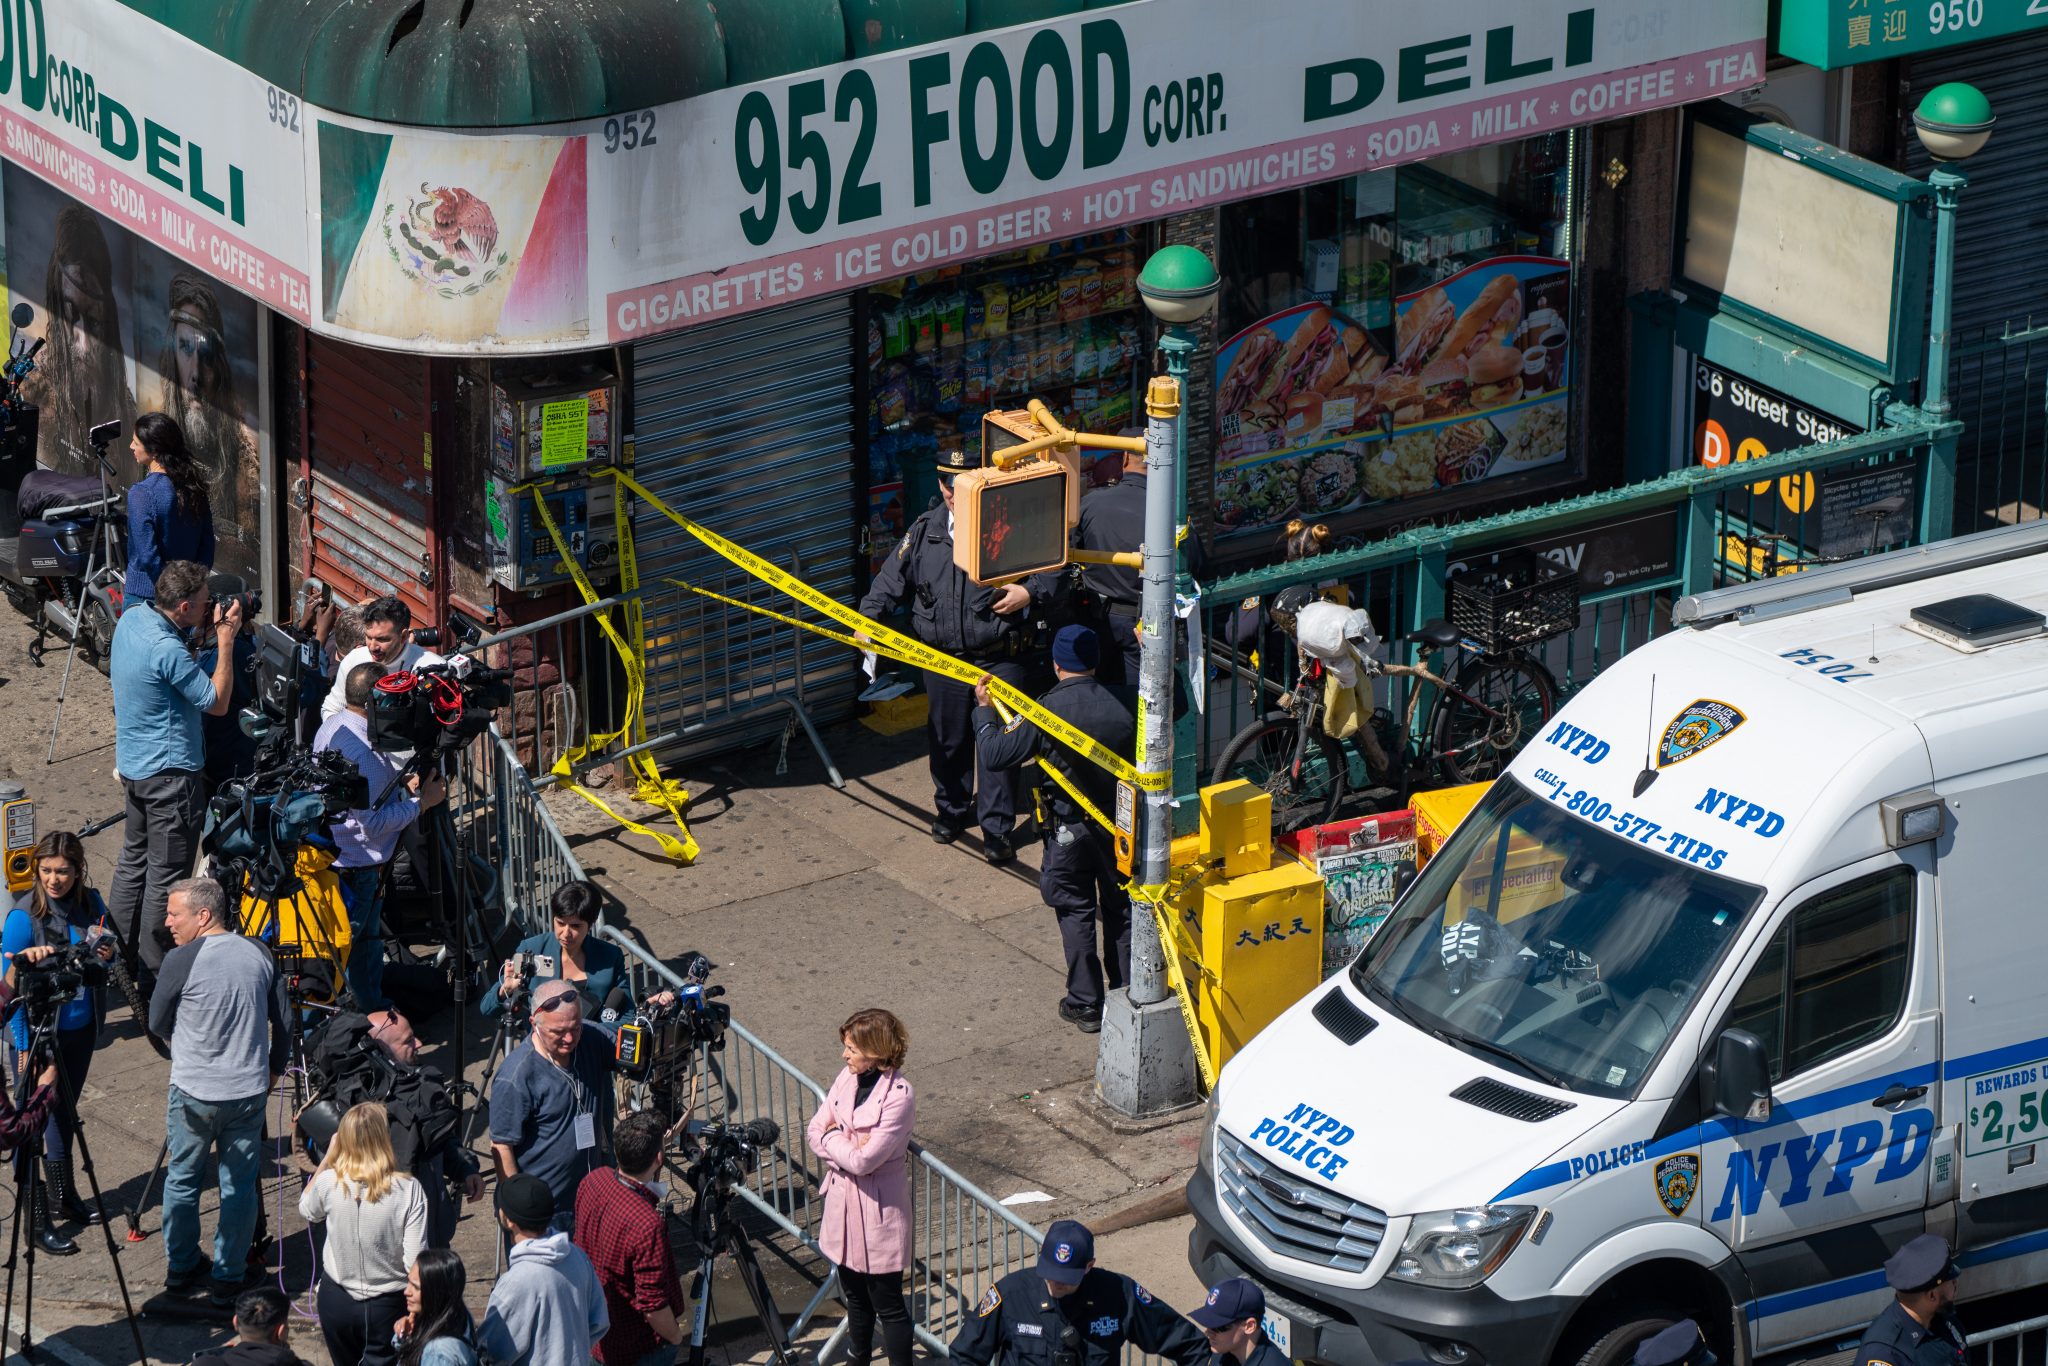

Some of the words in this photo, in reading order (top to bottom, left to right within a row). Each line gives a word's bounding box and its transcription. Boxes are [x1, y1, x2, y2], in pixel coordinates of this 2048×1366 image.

[1929, 0, 1983, 35] 950
[1302, 8, 1596, 124] DELI
[48, 53, 100, 138] CORP.
[267, 85, 299, 134] 952
[604, 109, 657, 154] 952
[735, 68, 882, 247] 952
[909, 18, 1131, 208] FOOD
[1143, 72, 1227, 148] CORP.
[100, 93, 245, 226] DELI
[617, 263, 805, 333] CIGARETTES
[835, 243, 882, 283] ICE
[890, 224, 966, 266] COLD
[976, 205, 1052, 247] BEER
[1083, 183, 1136, 223] HOT
[1150, 142, 1337, 211] SANDWICHES
[1366, 120, 1441, 164] SODA
[1471, 96, 1540, 139] MILK
[1569, 69, 1676, 118] COFFEE
[1705, 51, 1759, 88] TEA
[5, 118, 96, 195] SANDWICHES
[109, 179, 148, 224] SODA
[161, 206, 196, 253] MILK
[210, 240, 265, 290] COFFEE
[280, 273, 310, 315] TEA
[1697, 365, 1723, 398] 36
[1730, 380, 1789, 428] Street
[1704, 434, 1723, 463] D
[1667, 721, 1680, 739] CITY
[1684, 707, 1734, 732] DEPARTMENT
[1705, 702, 1737, 720] POLICE
[1545, 721, 1612, 766] NYPD
[1661, 742, 1669, 752] OF
[1672, 749, 1693, 762] NEW
[1696, 734, 1722, 750] YORK
[1534, 767, 1560, 787] CALL:
[1549, 780, 1728, 871] 1-800-577-TIPS
[1695, 787, 1786, 839] NYPD
[1975, 1067, 2037, 1096] REWARDS
[1283, 1102, 1356, 1148] NYPD
[1250, 1118, 1349, 1182] POLICE
[1570, 1140, 1646, 1181] POLICE
[1657, 1163, 1697, 1180] DEPARTMENT
[1665, 1156, 1689, 1168] POLICE
[1710, 1107, 1936, 1223] NYPD
[1090, 1319, 1119, 1330] POLICE
[1277, 1333, 1286, 1346] 16
